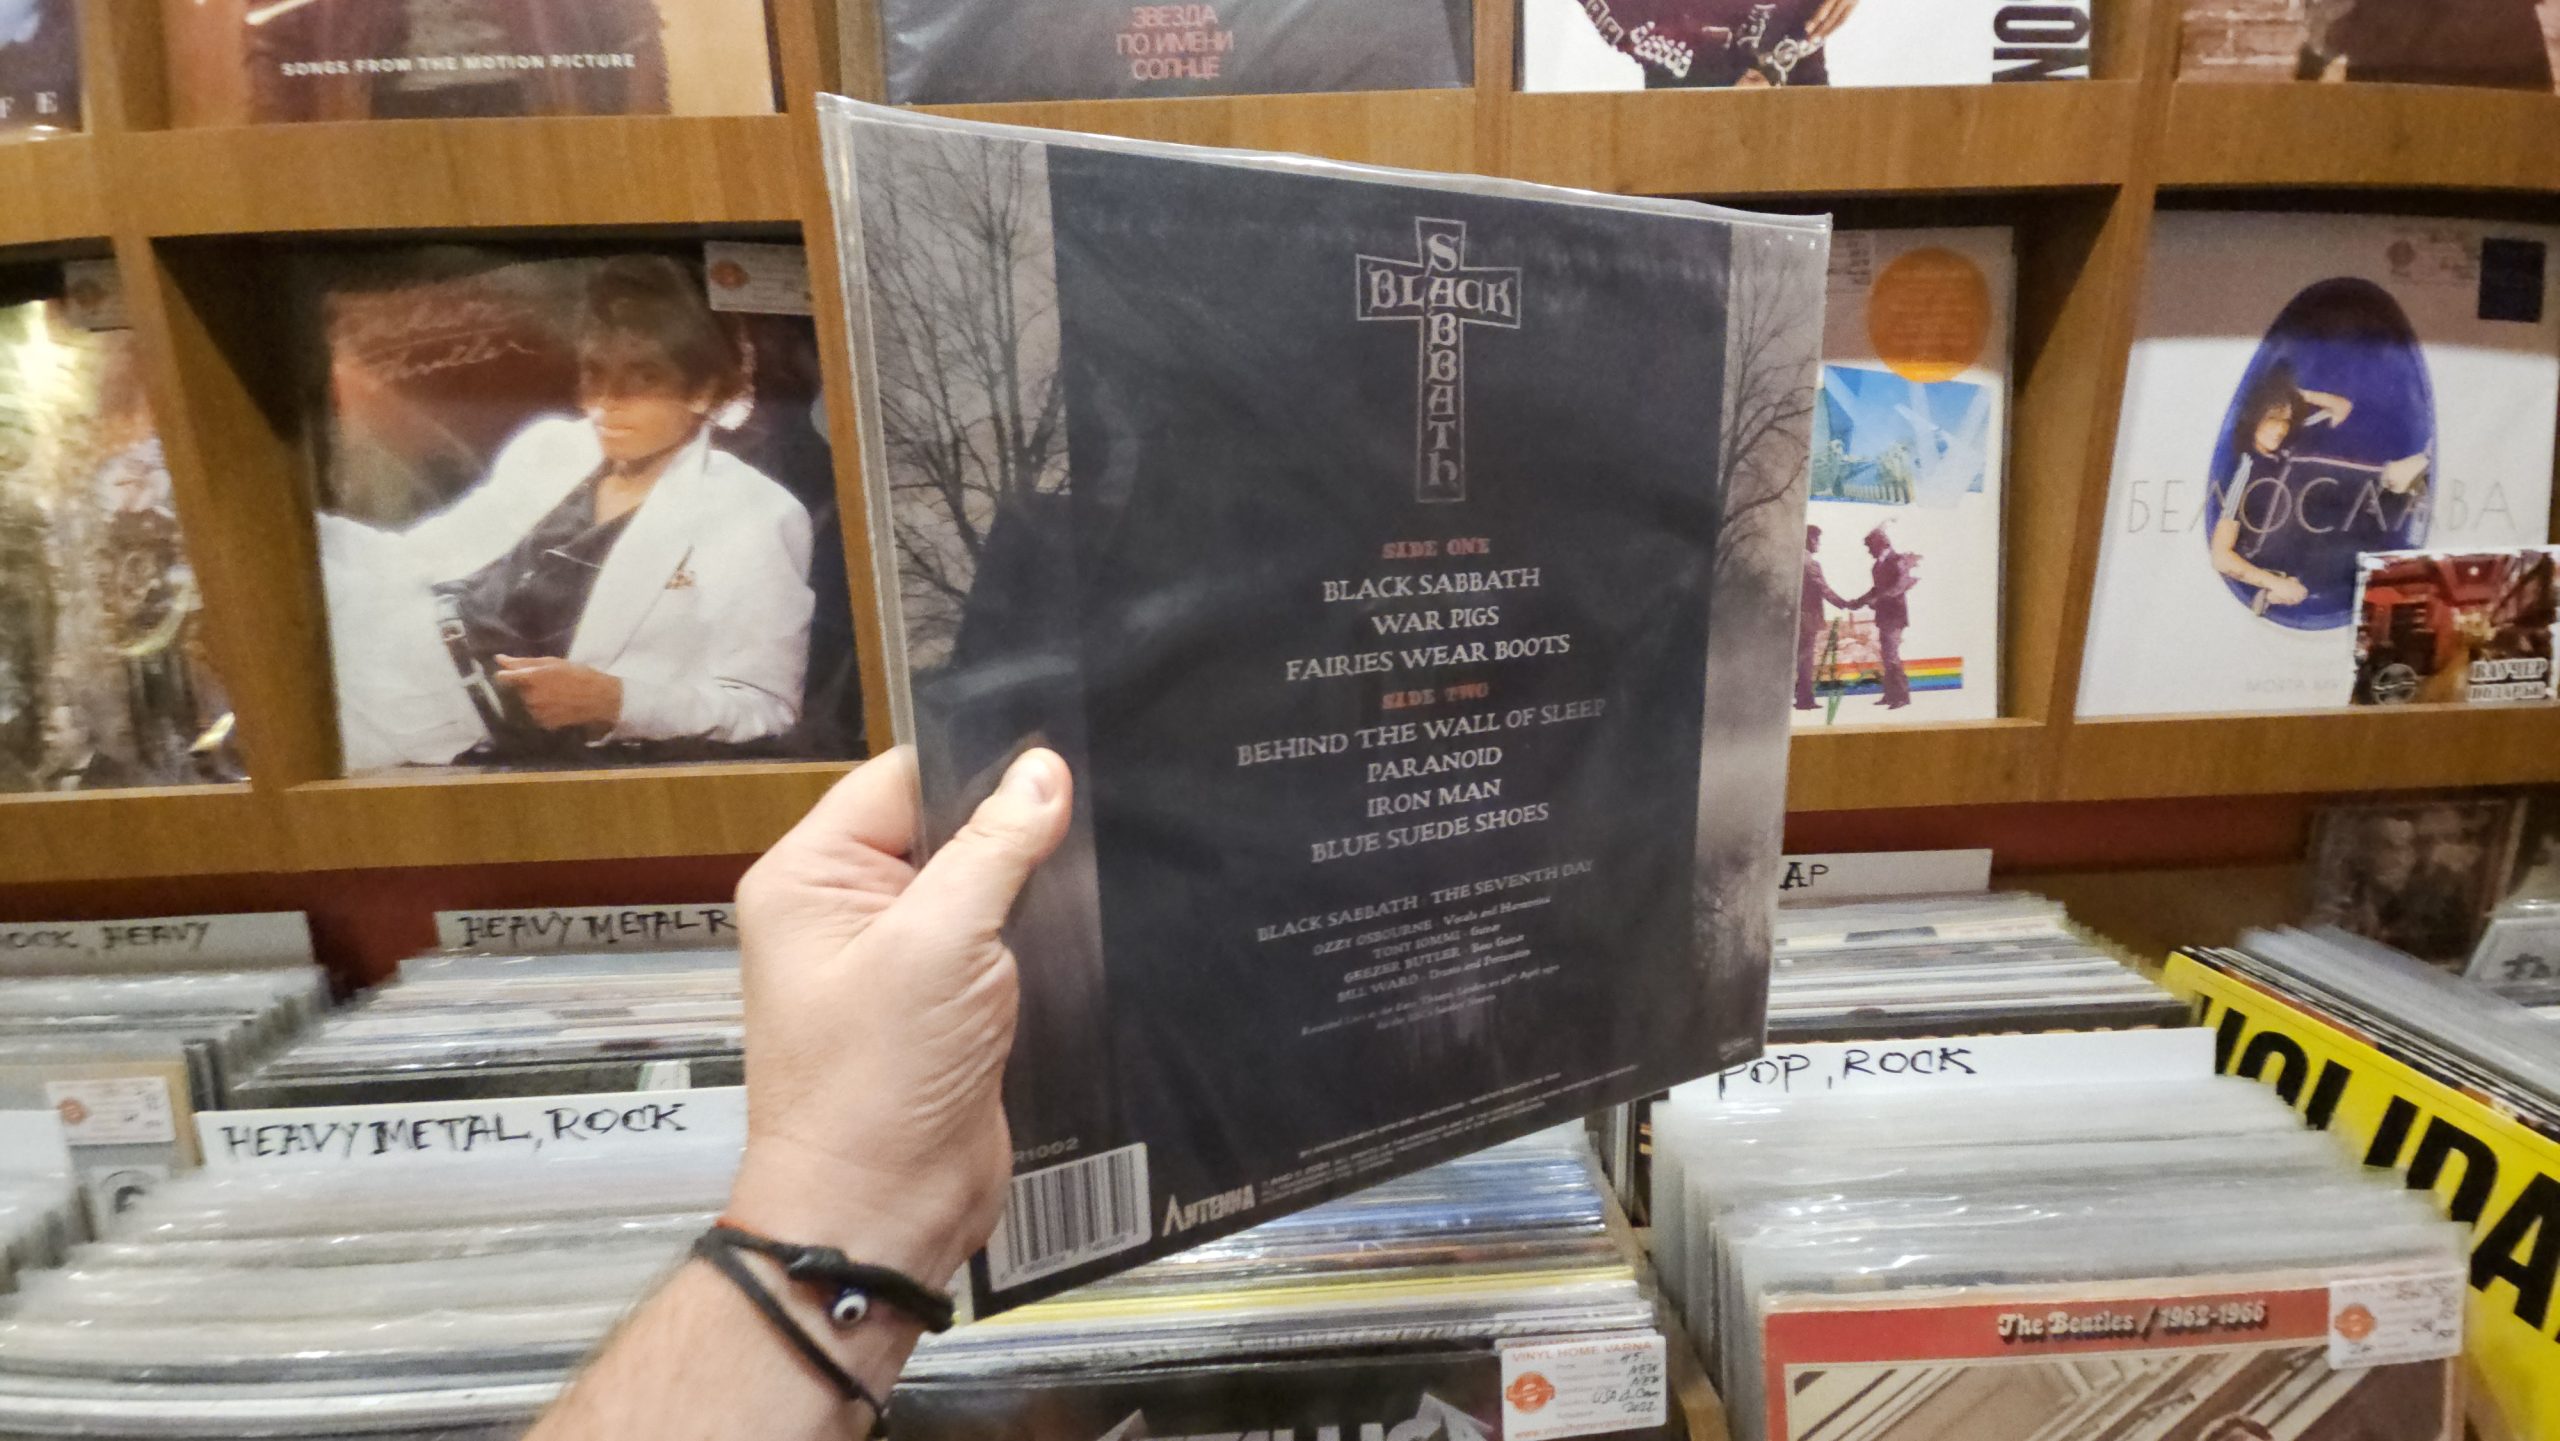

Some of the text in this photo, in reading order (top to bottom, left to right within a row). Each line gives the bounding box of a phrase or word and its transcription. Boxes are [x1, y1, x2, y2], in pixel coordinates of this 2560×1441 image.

[1131, 4, 1218, 28] ЗВЕЗДА
[1116, 30, 1233, 55] ПО ИМЕНИ
[281, 53, 636, 76] SONGS FROM THE MOTION PICTURE
[1131, 56, 1219, 80] СОЛНЦЕ
[1367, 263, 1512, 317] BLACK
[1426, 232, 1459, 487] SABBATH
[1382, 537, 1491, 559] SIDE ONE
[1323, 567, 1541, 602] BLACK SABBATH
[1371, 606, 1500, 635] WAR PIGS
[1286, 634, 1571, 681] FAIRIES WEAR BOOTS
[1382, 682, 1489, 711] SIDE TWO
[1236, 699, 1607, 766] BEHIND THE WALL OF SLEEP
[1367, 747, 1503, 784] PARANOID
[1367, 779, 1502, 818] IRON MAN
[1311, 803, 1549, 863] BLUE SUEDE SHOES
[1257, 859, 1594, 942] BLACK SABBATH THE SEVENTH DAY
[457, 911, 574, 948] HEAVY
[583, 911, 699, 944] METAL
[1313, 937, 1353, 956] OZZY
[221, 1121, 358, 1158] HEAVY
[544, 1103, 688, 1142] ROCK
[1998, 1312, 2045, 1340] The
[2048, 1309, 2137, 1338] Beatles
[2159, 1300, 2269, 1331] 1962-1966
[1557, 1345, 1600, 1358] HOME
